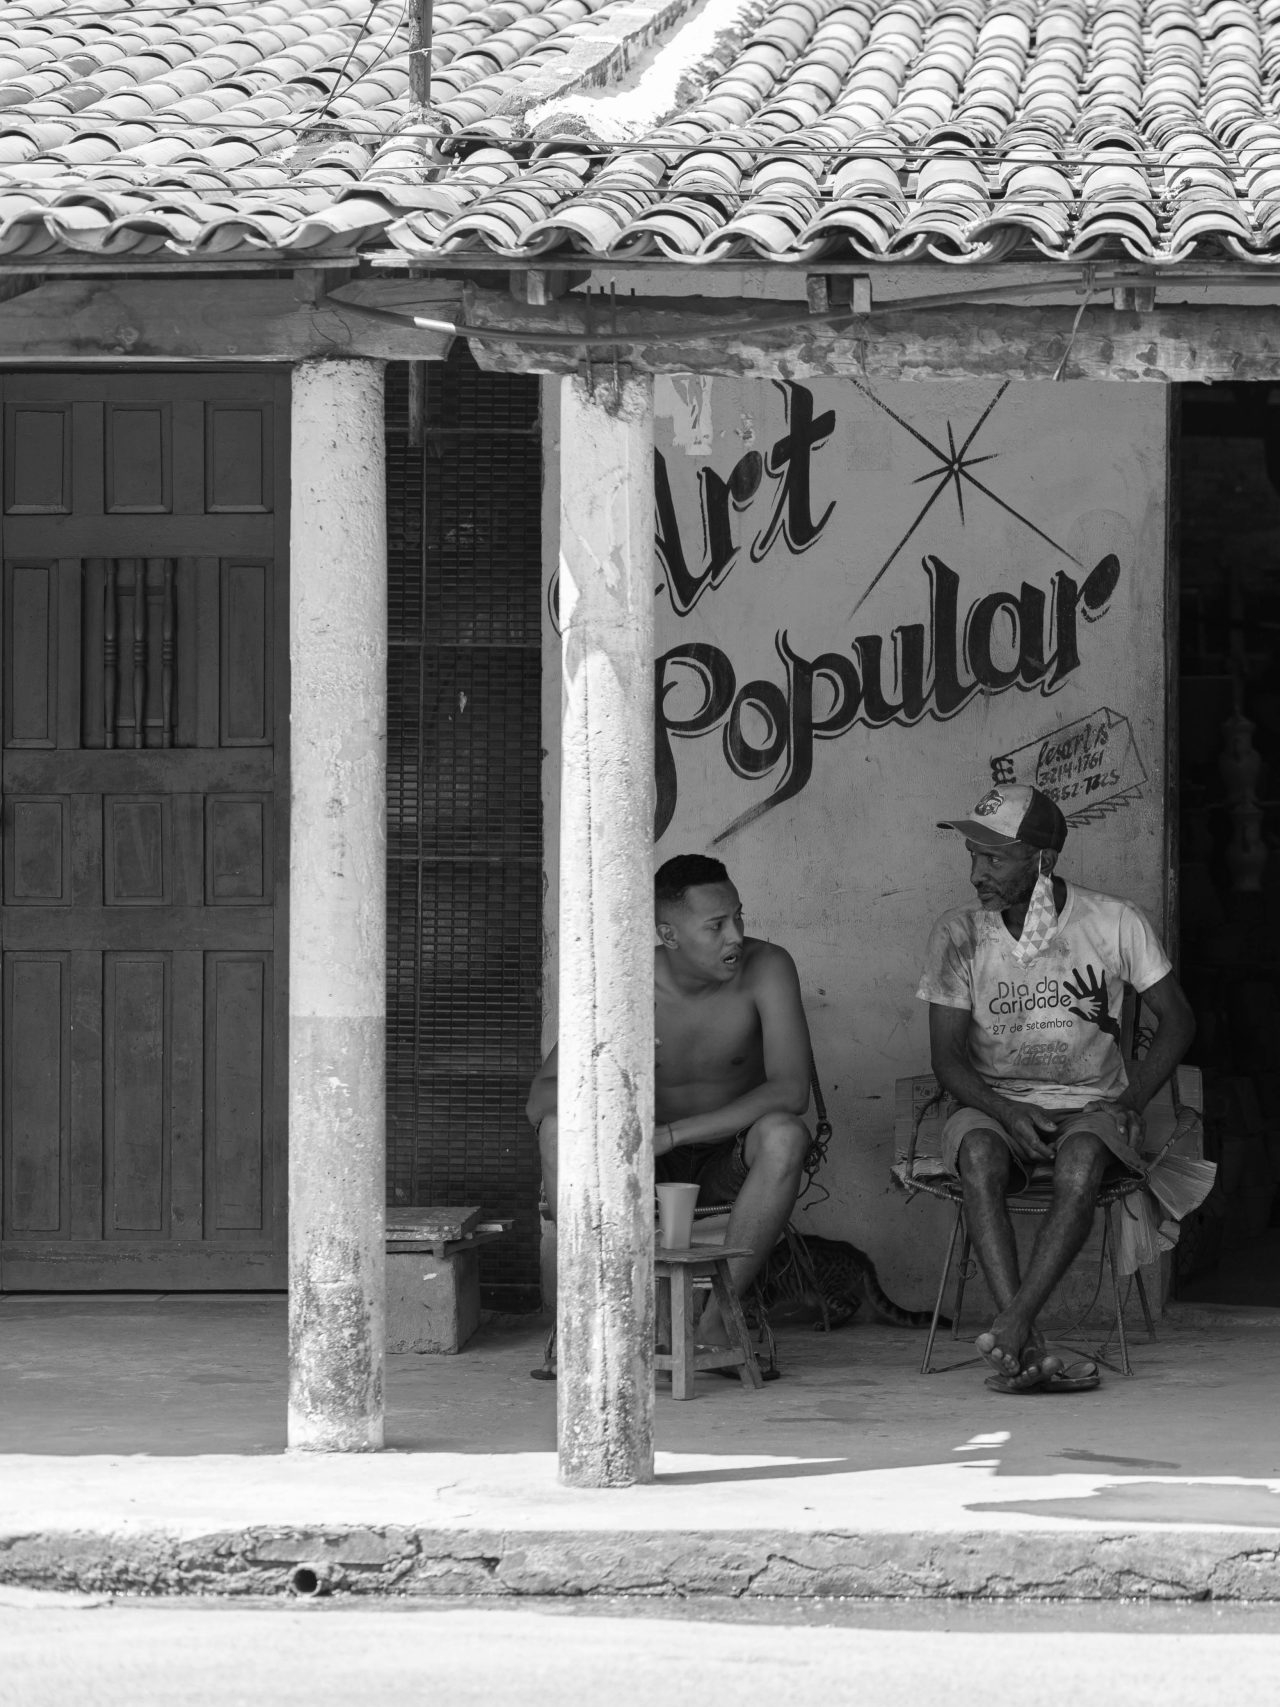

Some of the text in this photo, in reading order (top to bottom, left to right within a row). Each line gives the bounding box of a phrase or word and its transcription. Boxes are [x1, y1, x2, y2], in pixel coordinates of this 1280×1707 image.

[655, 554, 1121, 850] Popular
[997, 976, 1059, 999] Dia da
[988, 992, 1072, 1015] Caridade
[992, 1018, 1074, 1036] 27 de setembro
